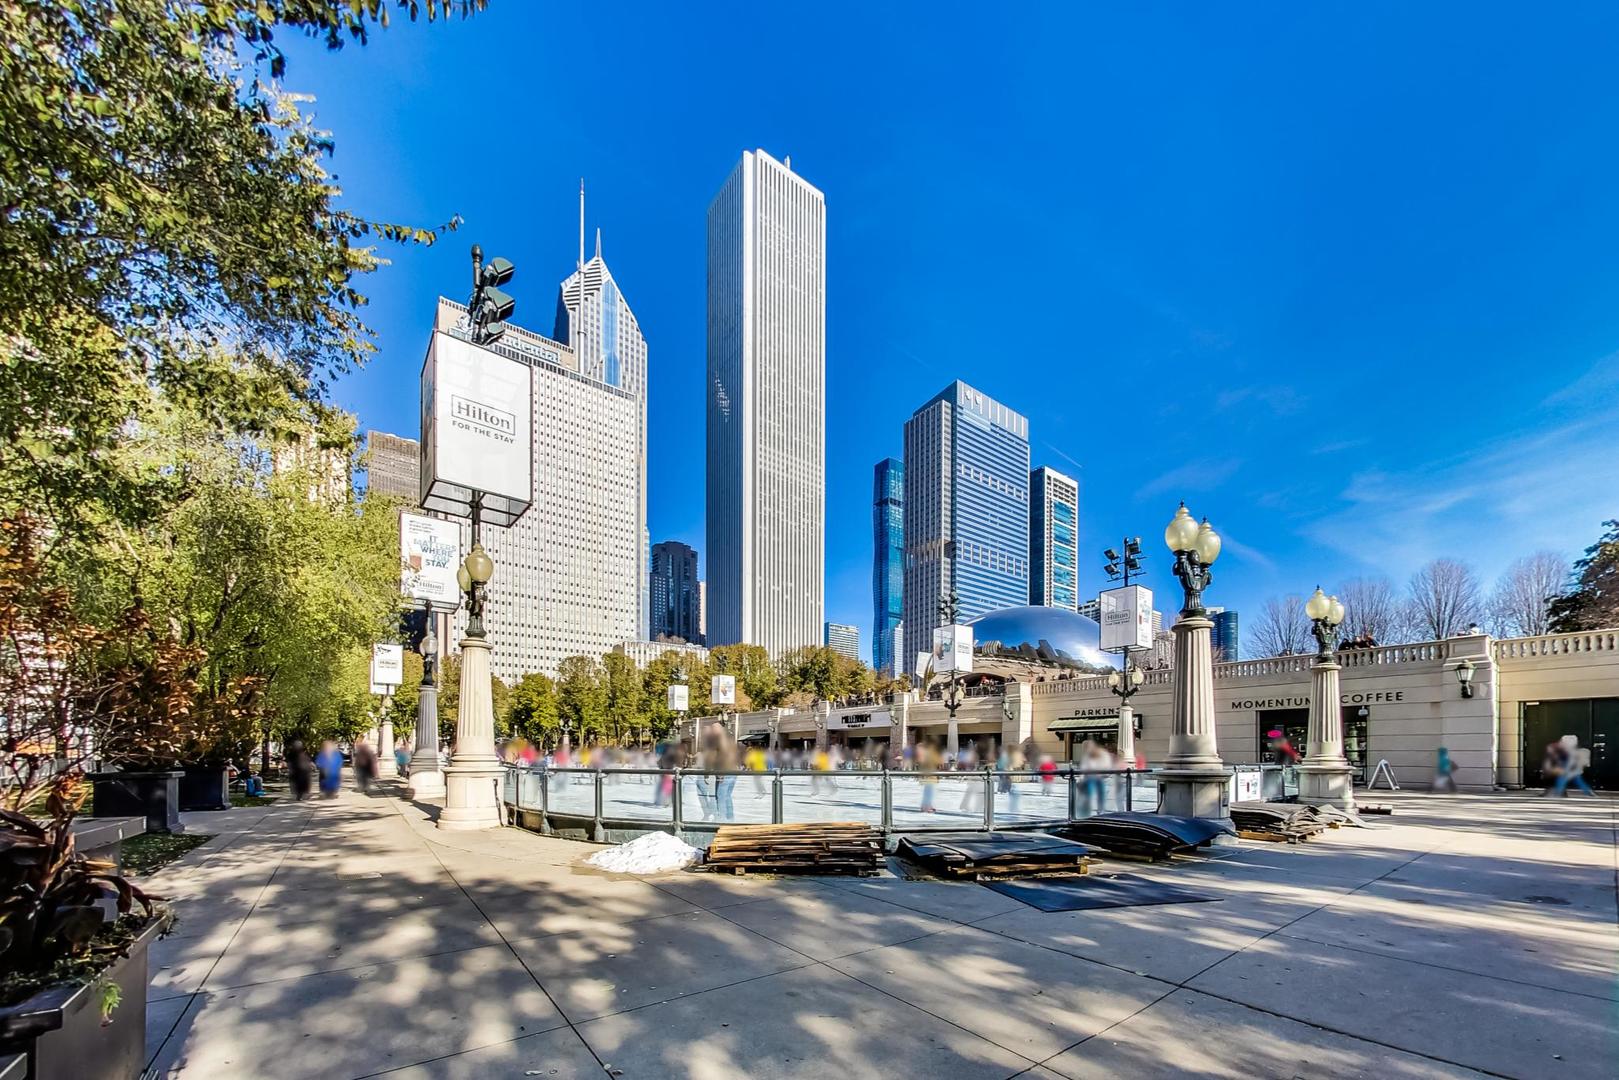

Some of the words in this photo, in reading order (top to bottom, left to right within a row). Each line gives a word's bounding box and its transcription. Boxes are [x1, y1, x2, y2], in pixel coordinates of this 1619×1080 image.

[457, 401, 510, 430] Hilton
[452, 420, 471, 431] FOR
[473, 426, 491, 438] THE
[494, 433, 514, 444] STAY
[1340, 691, 1404, 705] COFFEE
